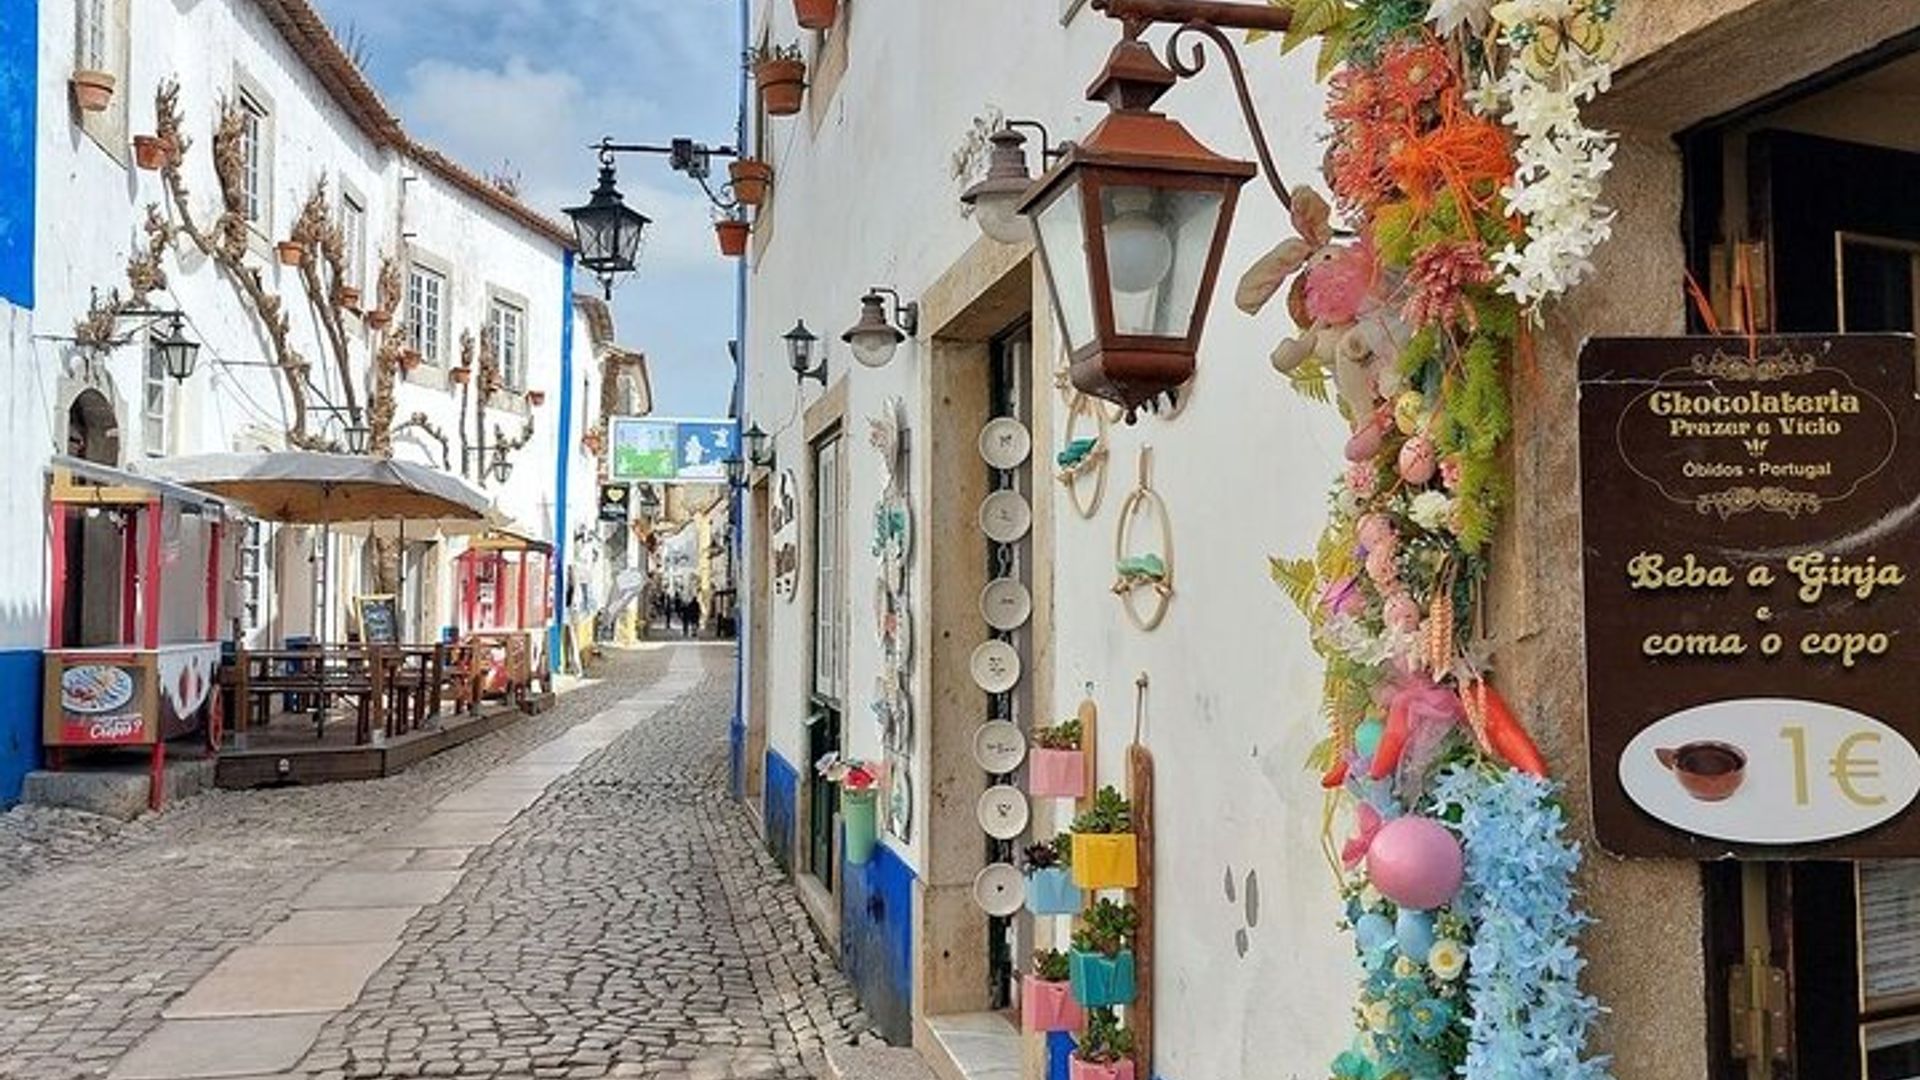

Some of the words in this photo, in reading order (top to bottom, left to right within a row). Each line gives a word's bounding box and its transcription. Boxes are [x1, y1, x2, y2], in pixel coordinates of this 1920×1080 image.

[1649, 388, 1860, 415] Chocolateria
[1670, 418, 1750, 436] Prazer
[1756, 422, 1771, 435] e
[1682, 460, 1744, 477] Óbidos
[1759, 461, 1832, 480] Portugal
[1627, 552, 1734, 589] Beba
[1747, 565, 1775, 587] a
[1786, 552, 1906, 603] Ginja
[1756, 606, 1772, 621] e
[1642, 633, 1748, 655] coma
[1760, 633, 1782, 654] o
[1800, 633, 1889, 667] copo
